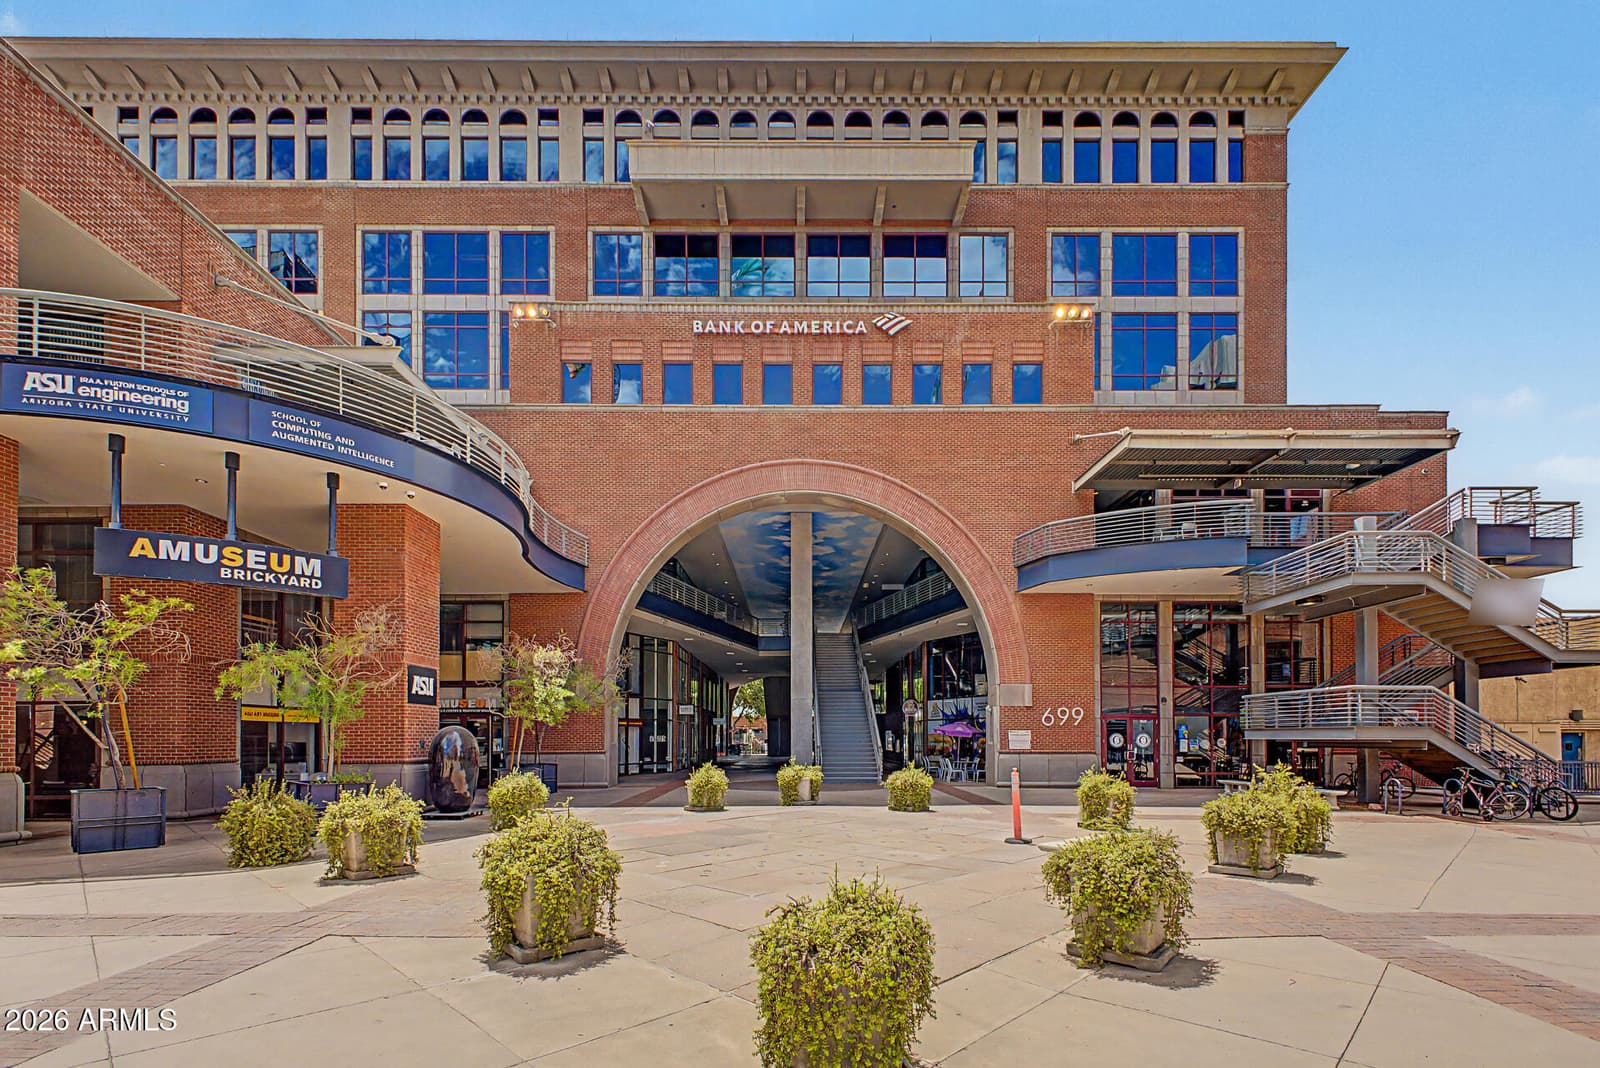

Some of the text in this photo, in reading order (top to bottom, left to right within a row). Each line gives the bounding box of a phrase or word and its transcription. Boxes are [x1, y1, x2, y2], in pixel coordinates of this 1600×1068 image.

[692, 320, 868, 334] BANK OF AMERICA
[23, 371, 75, 394] ASU
[79, 376, 93, 384] IRA
[104, 379, 135, 390] FULTON
[135, 383, 176, 396] SCHOOLS
[177, 390, 189, 398] OF
[77, 384, 190, 413] engineering
[22, 397, 190, 423] ARIZONA STATE UNIVERSITY
[271, 410, 322, 428] SCHOOL OF
[271, 420, 355, 447] COMPUTING AND
[271, 430, 395, 469] AUGMENTED INTELLIGENCE
[128, 537, 322, 578] AMUSEUM
[219, 567, 323, 589] BRICKYARD
[411, 675, 434, 697] ASU
[1041, 707, 1084, 727] 699
